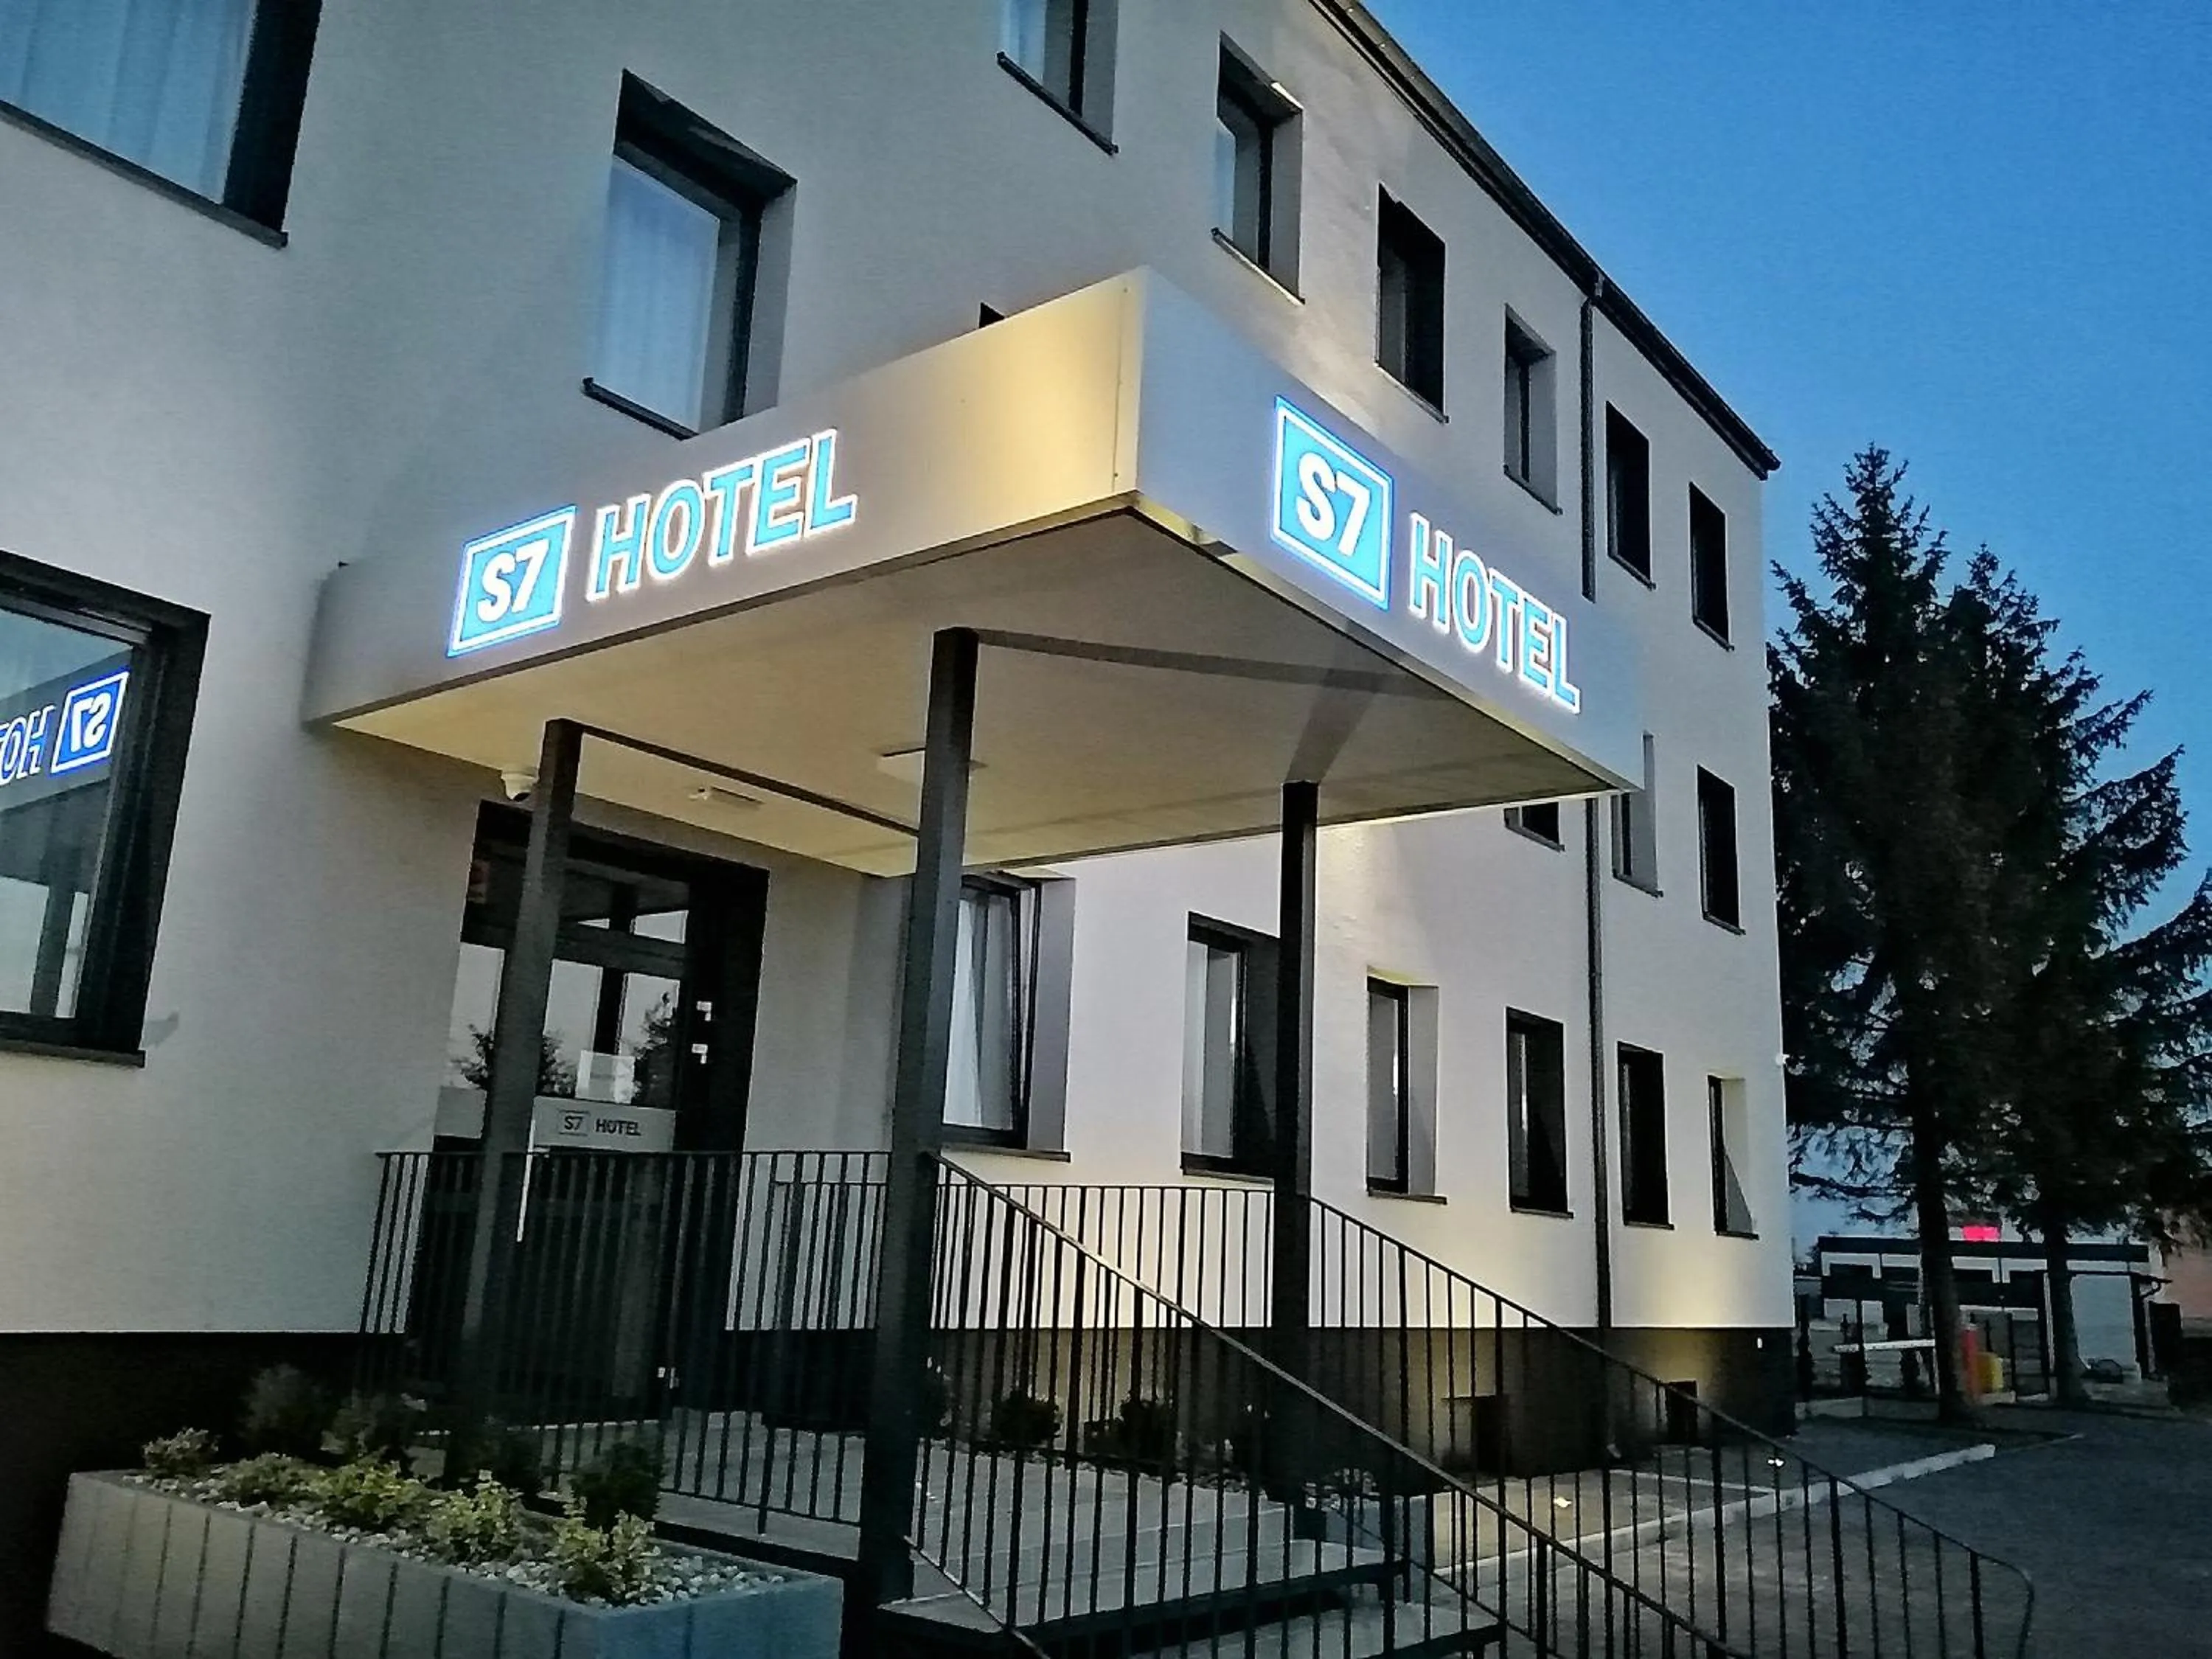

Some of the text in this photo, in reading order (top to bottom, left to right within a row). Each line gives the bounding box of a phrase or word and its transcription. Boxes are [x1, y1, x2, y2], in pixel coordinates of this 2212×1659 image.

[476, 428, 858, 623] S7 HOTEL
[1295, 451, 1581, 714] S7 HOTEL
[563, 1116, 641, 1136] S7 HOTEL
